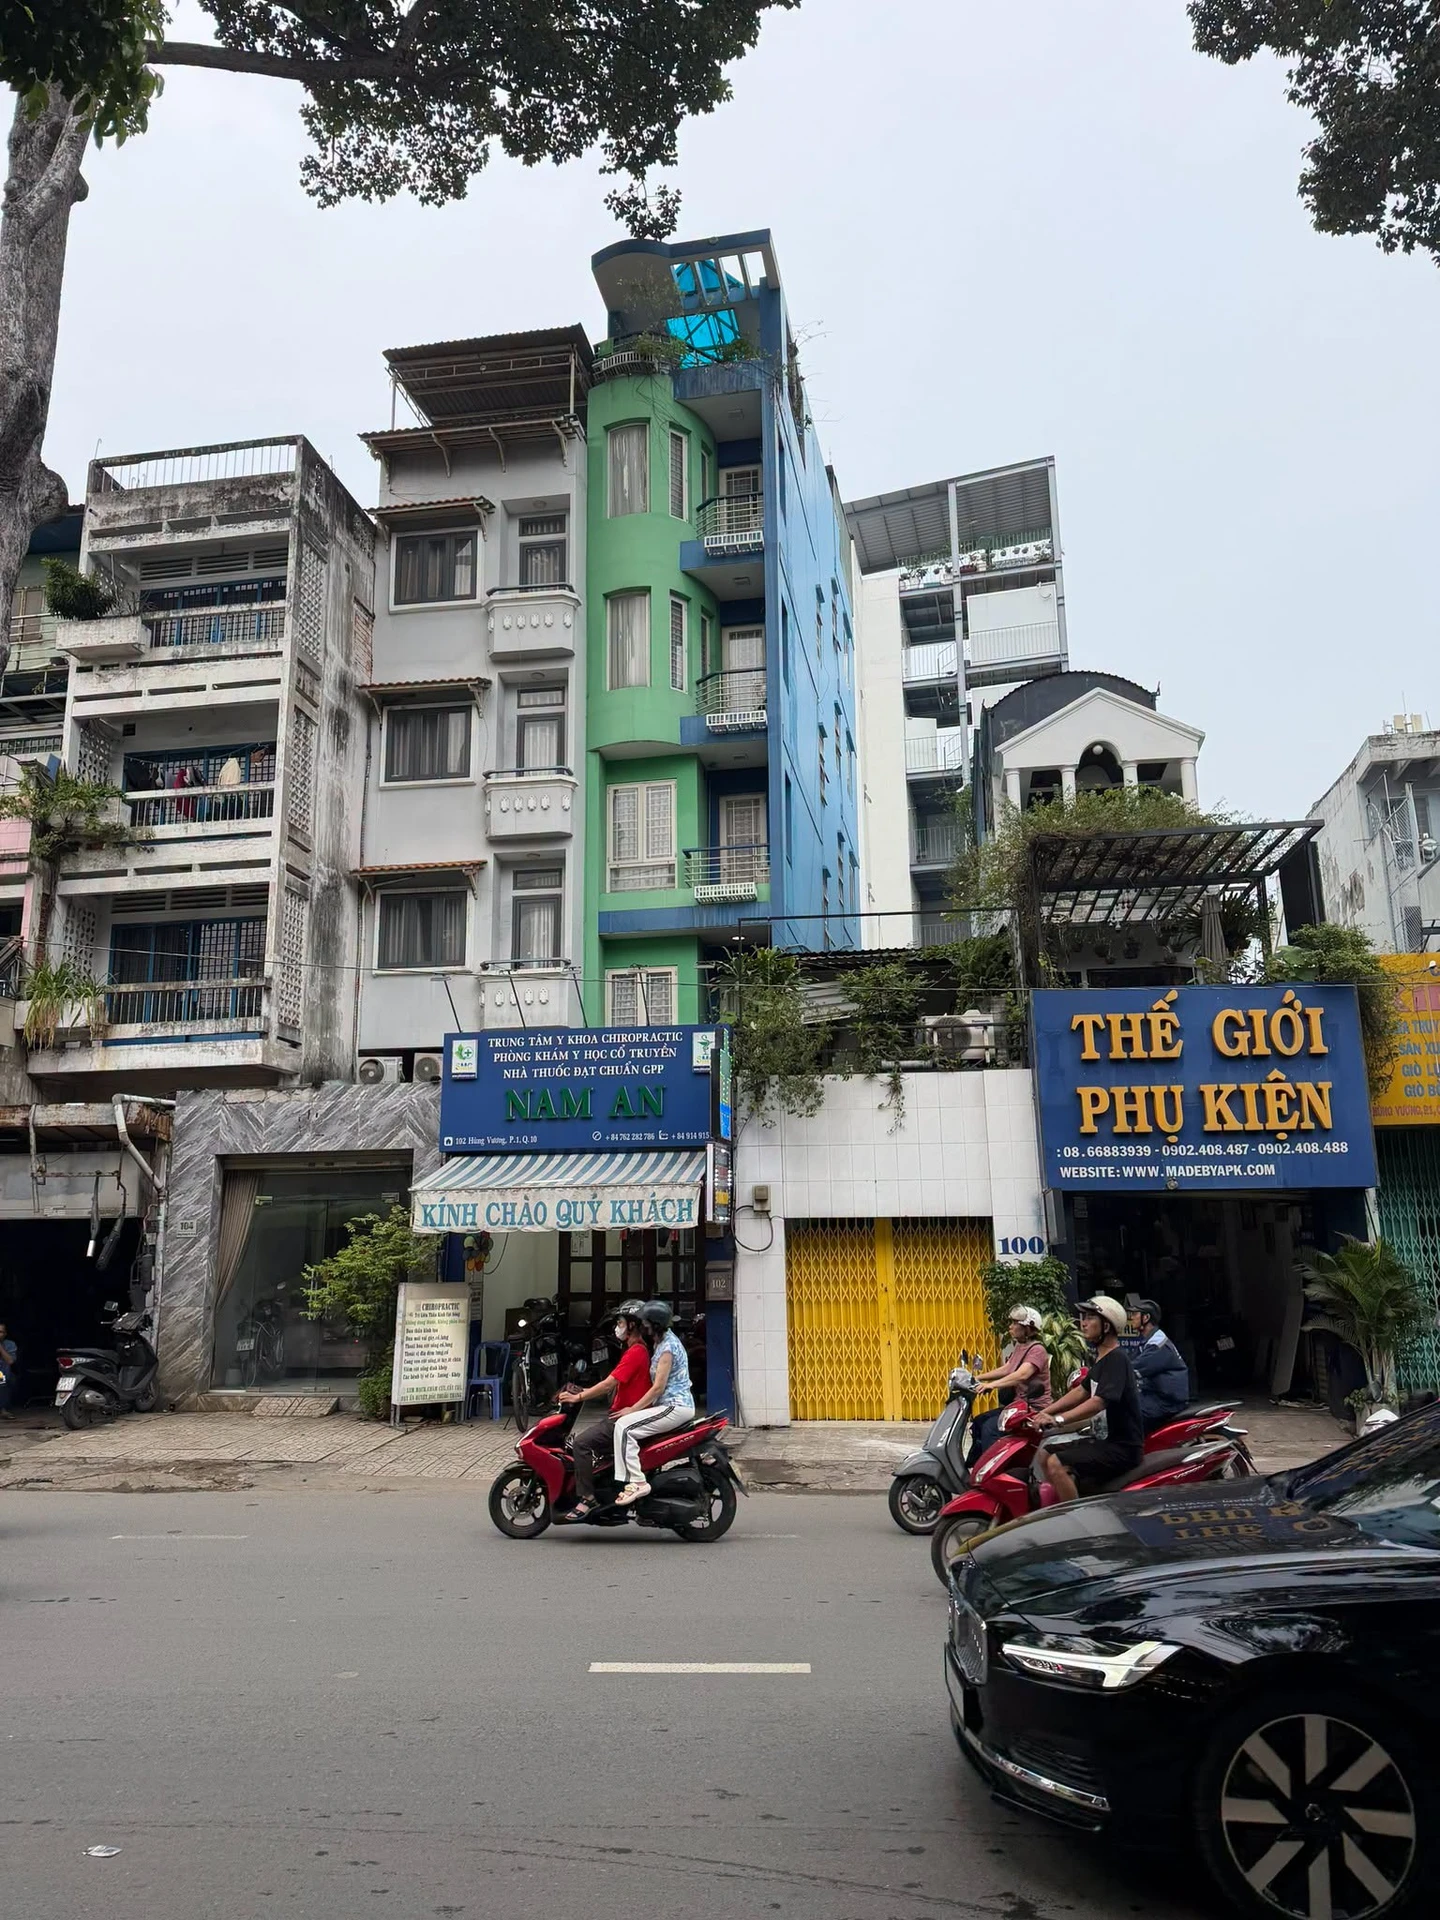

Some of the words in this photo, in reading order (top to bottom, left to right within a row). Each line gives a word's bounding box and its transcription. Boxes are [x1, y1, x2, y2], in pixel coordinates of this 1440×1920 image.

[1070, 989, 1184, 1060] THẾ
[1211, 989, 1329, 1057] GIỚI
[488, 1036, 525, 1048] TRUNG
[528, 1033, 552, 1046] TÂM
[556, 1035, 564, 1045] Y
[567, 1034, 598, 1045] KHOA
[601, 1031, 683, 1044] CHIROPRACTIC
[493, 1049, 531, 1063] PHÒNG
[535, 1047, 569, 1061] KHÁM
[572, 1050, 580, 1060] Y
[584, 1048, 608, 1062] HỌC
[610, 1043, 626, 1059] CỔ
[629, 1042, 677, 1059] TRUYỀN
[503, 1065, 528, 1079] NHÀ
[532, 1062, 571, 1078] THUỐC
[573, 1065, 596, 1079] ĐẠT
[599, 1060, 640, 1076] CHUẨN
[642, 1064, 664, 1075] GPP
[505, 1086, 594, 1121] NAM
[608, 1085, 667, 1119] AN
[1076, 1084, 1185, 1143] PHỤ
[1198, 1068, 1333, 1141] KIỆN
[455, 1137, 467, 1145] 102
[421, 1196, 478, 1228] KÍNH
[484, 1194, 548, 1227] CHÀO
[555, 1192, 603, 1229] QUÝ
[609, 1191, 694, 1224] KHÁCH
[998, 1236, 1045, 1256] 100
[711, 1278, 727, 1289] 102
